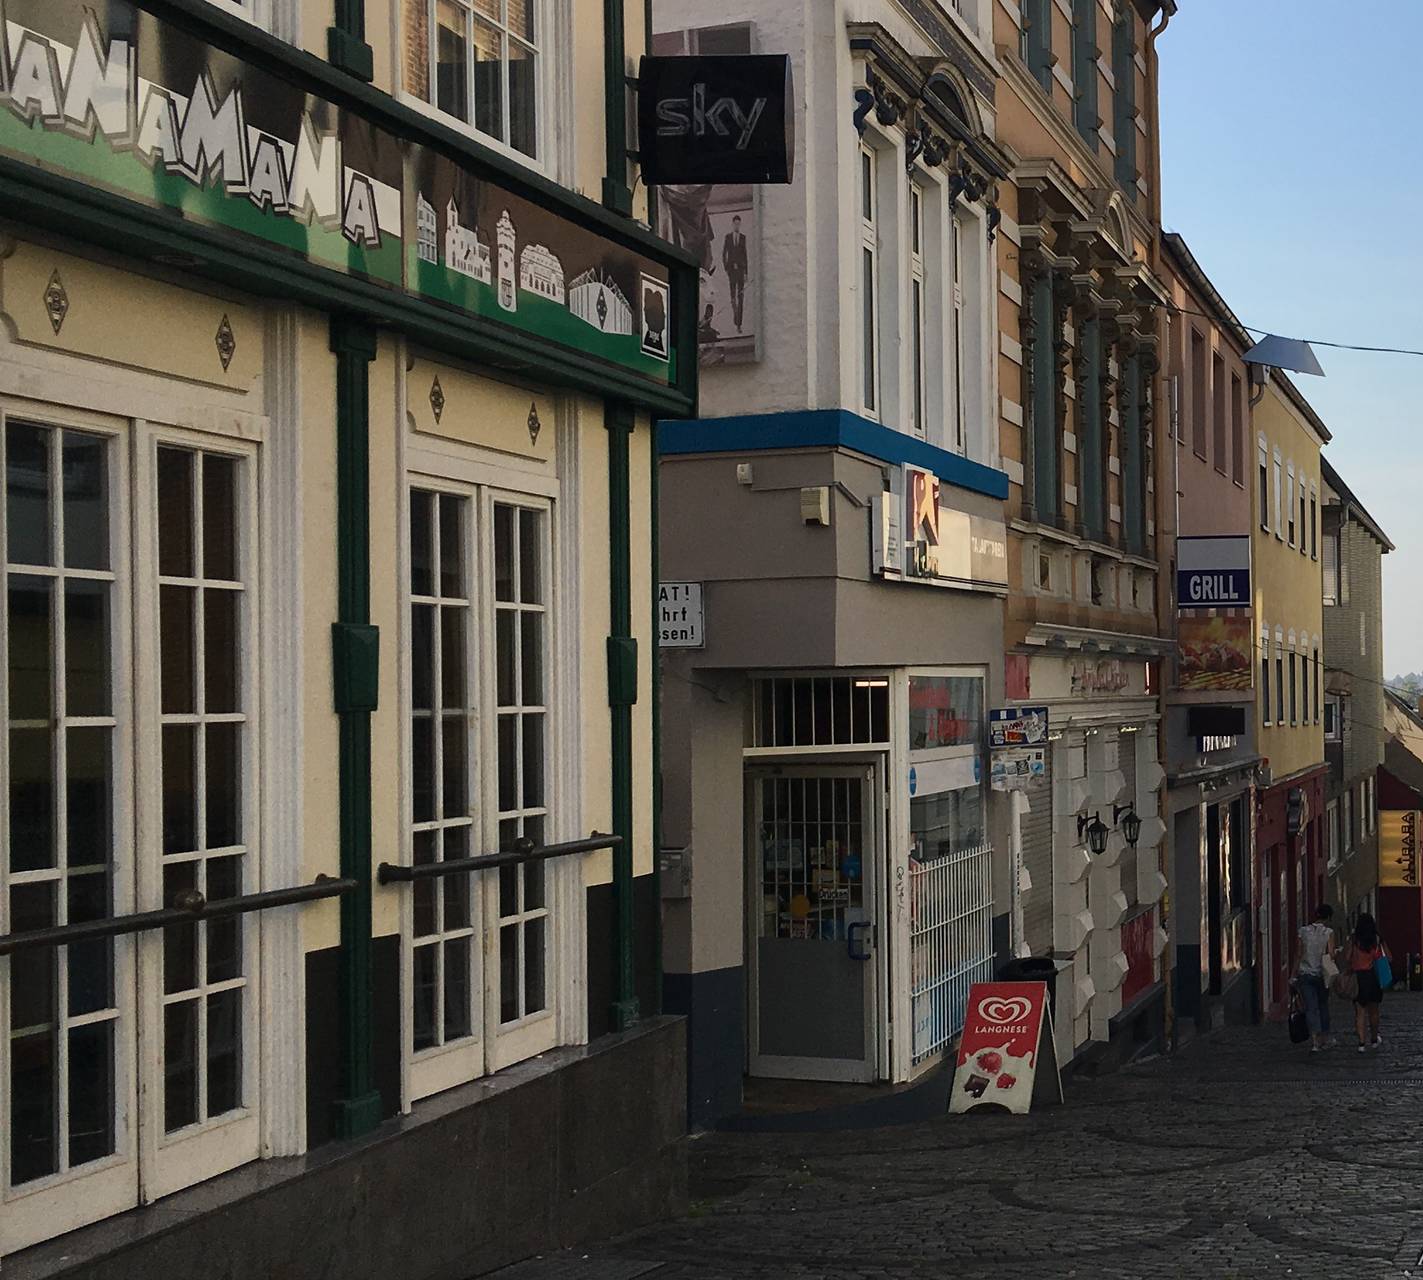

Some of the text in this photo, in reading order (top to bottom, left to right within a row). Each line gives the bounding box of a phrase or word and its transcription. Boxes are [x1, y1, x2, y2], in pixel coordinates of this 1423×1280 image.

[656, 82, 768, 151] sky
[659, 585, 690, 601] AT!
[1189, 575, 1239, 600] GRILL
[662, 607, 687, 622] hrt
[659, 625, 694, 640] sen!
[1399, 813, 1414, 884] ALIBABA
[975, 1025, 1027, 1034] LANGNESE
